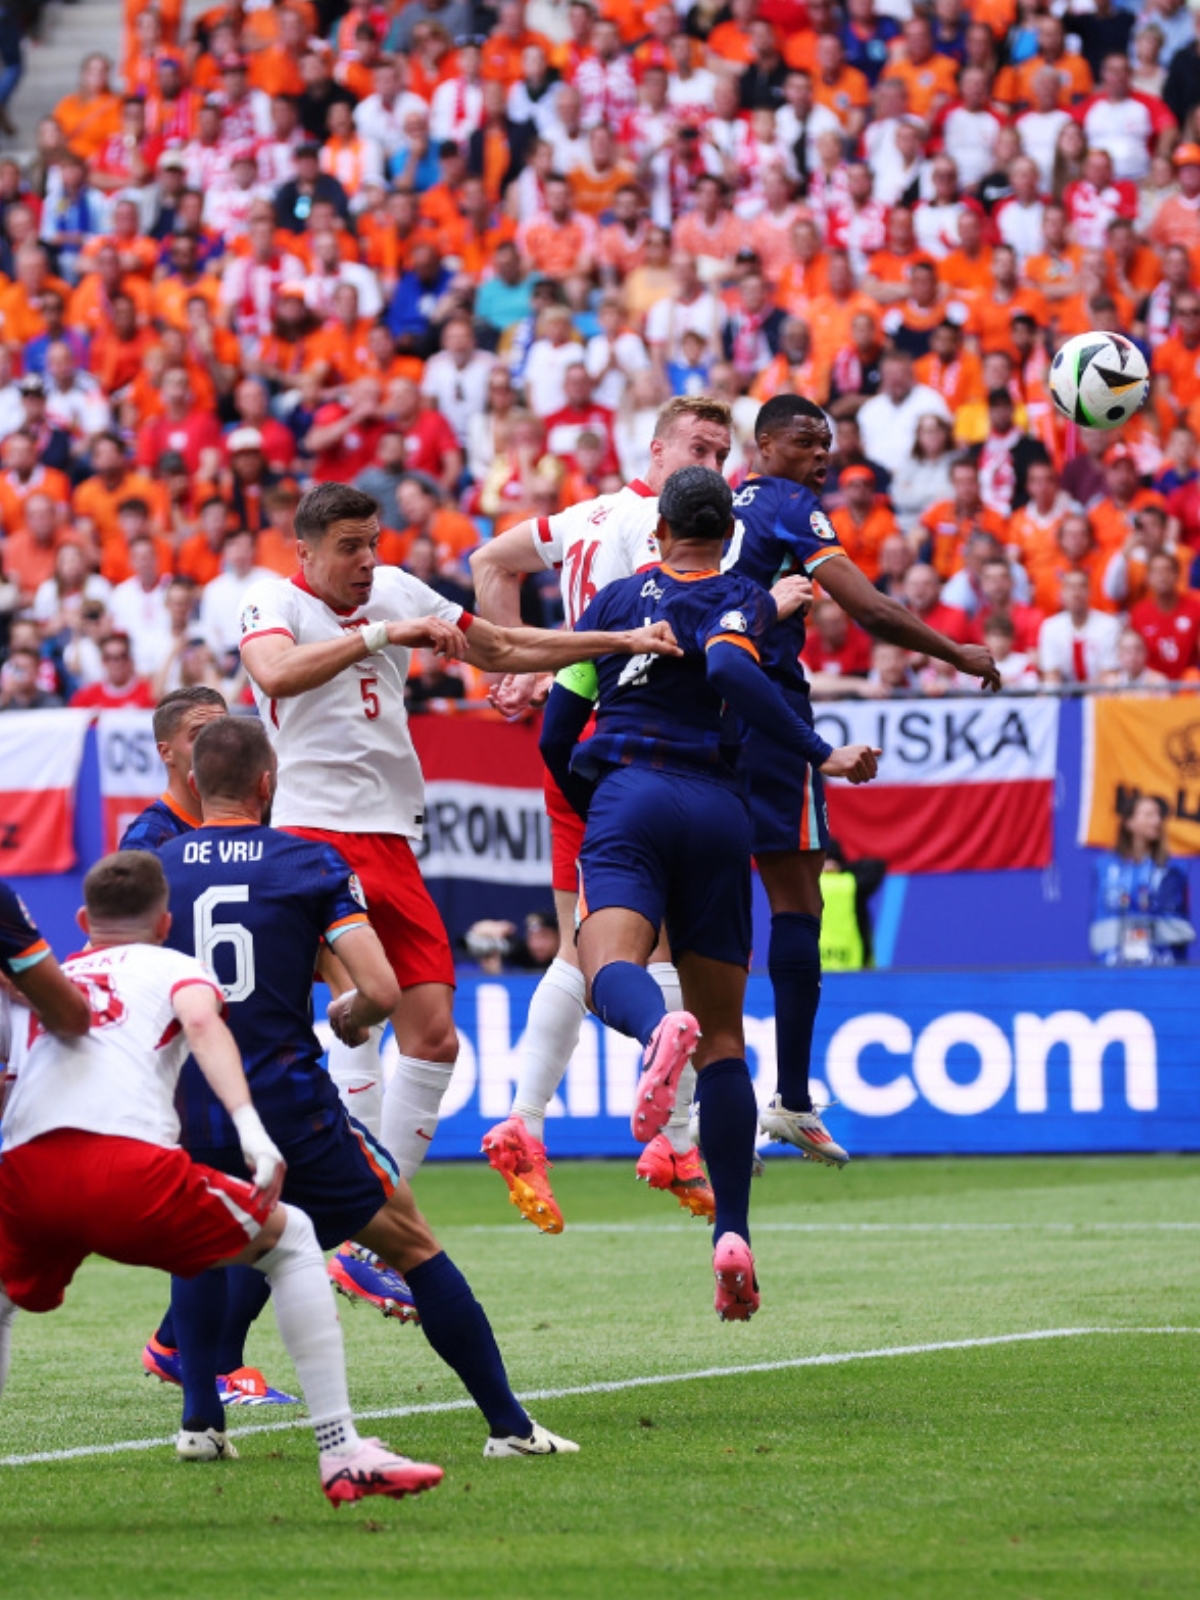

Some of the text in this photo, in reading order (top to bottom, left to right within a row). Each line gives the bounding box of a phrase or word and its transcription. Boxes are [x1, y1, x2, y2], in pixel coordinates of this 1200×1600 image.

[360, 677, 380, 721] 5
[105, 730, 166, 777] OS
[183, 841, 212, 864] DE
[192, 884, 256, 1002] 6
